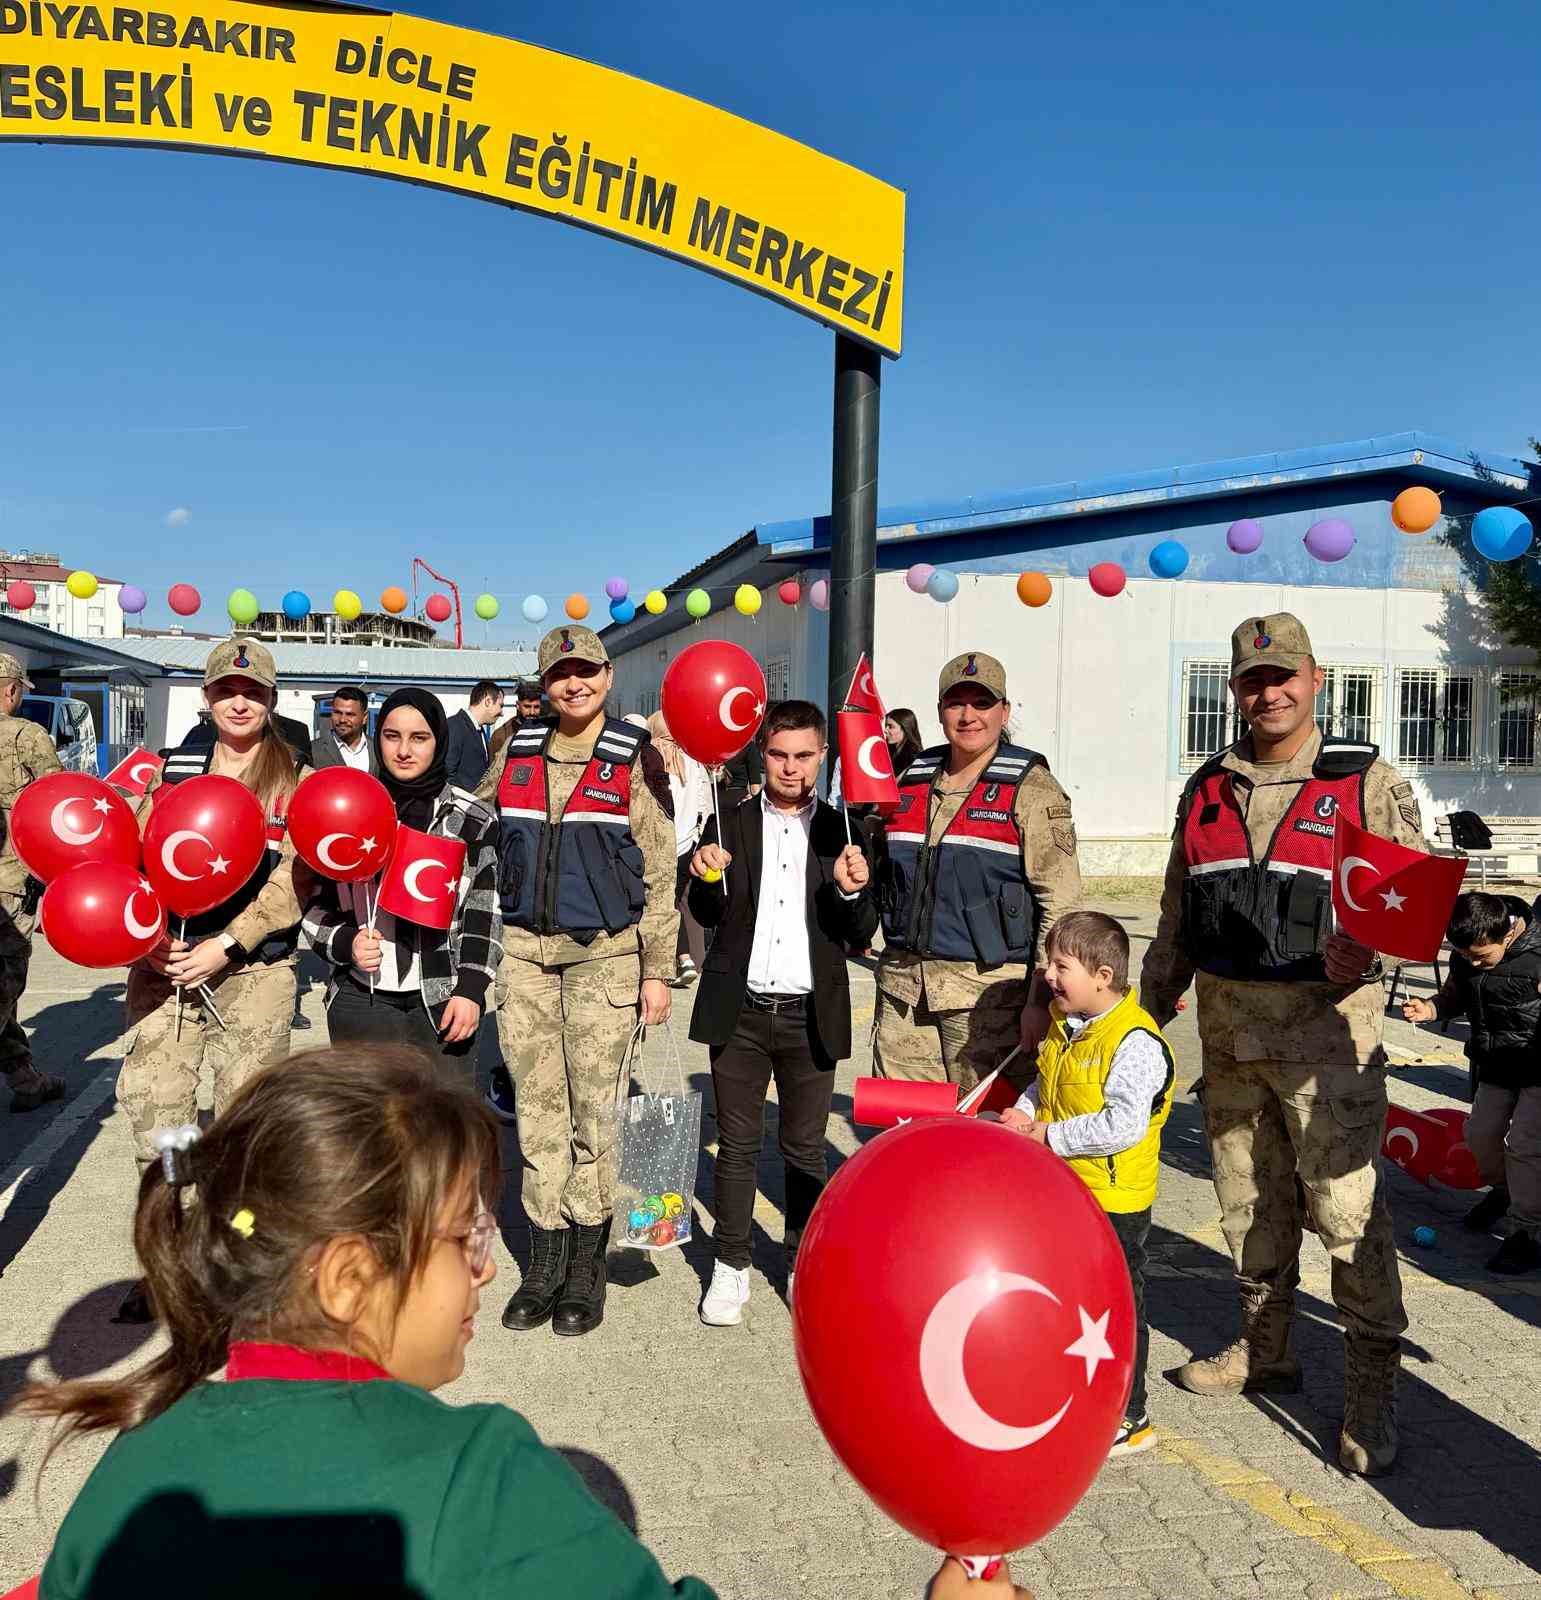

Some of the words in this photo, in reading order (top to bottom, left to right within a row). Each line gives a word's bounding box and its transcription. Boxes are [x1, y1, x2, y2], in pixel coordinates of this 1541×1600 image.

[336, 36, 477, 101] DİCLE
[0, 63, 193, 129] ESLEKİ
[215, 93, 272, 136] ve
[294, 90, 491, 177] TEKNİK
[505, 132, 677, 235] EĞİTİM
[688, 197, 894, 332] MERKEZİ
[585, 788, 620, 803] JANDARMA
[970, 810, 1008, 820] JANDARMA
[1299, 821, 1334, 835] JANDAR
